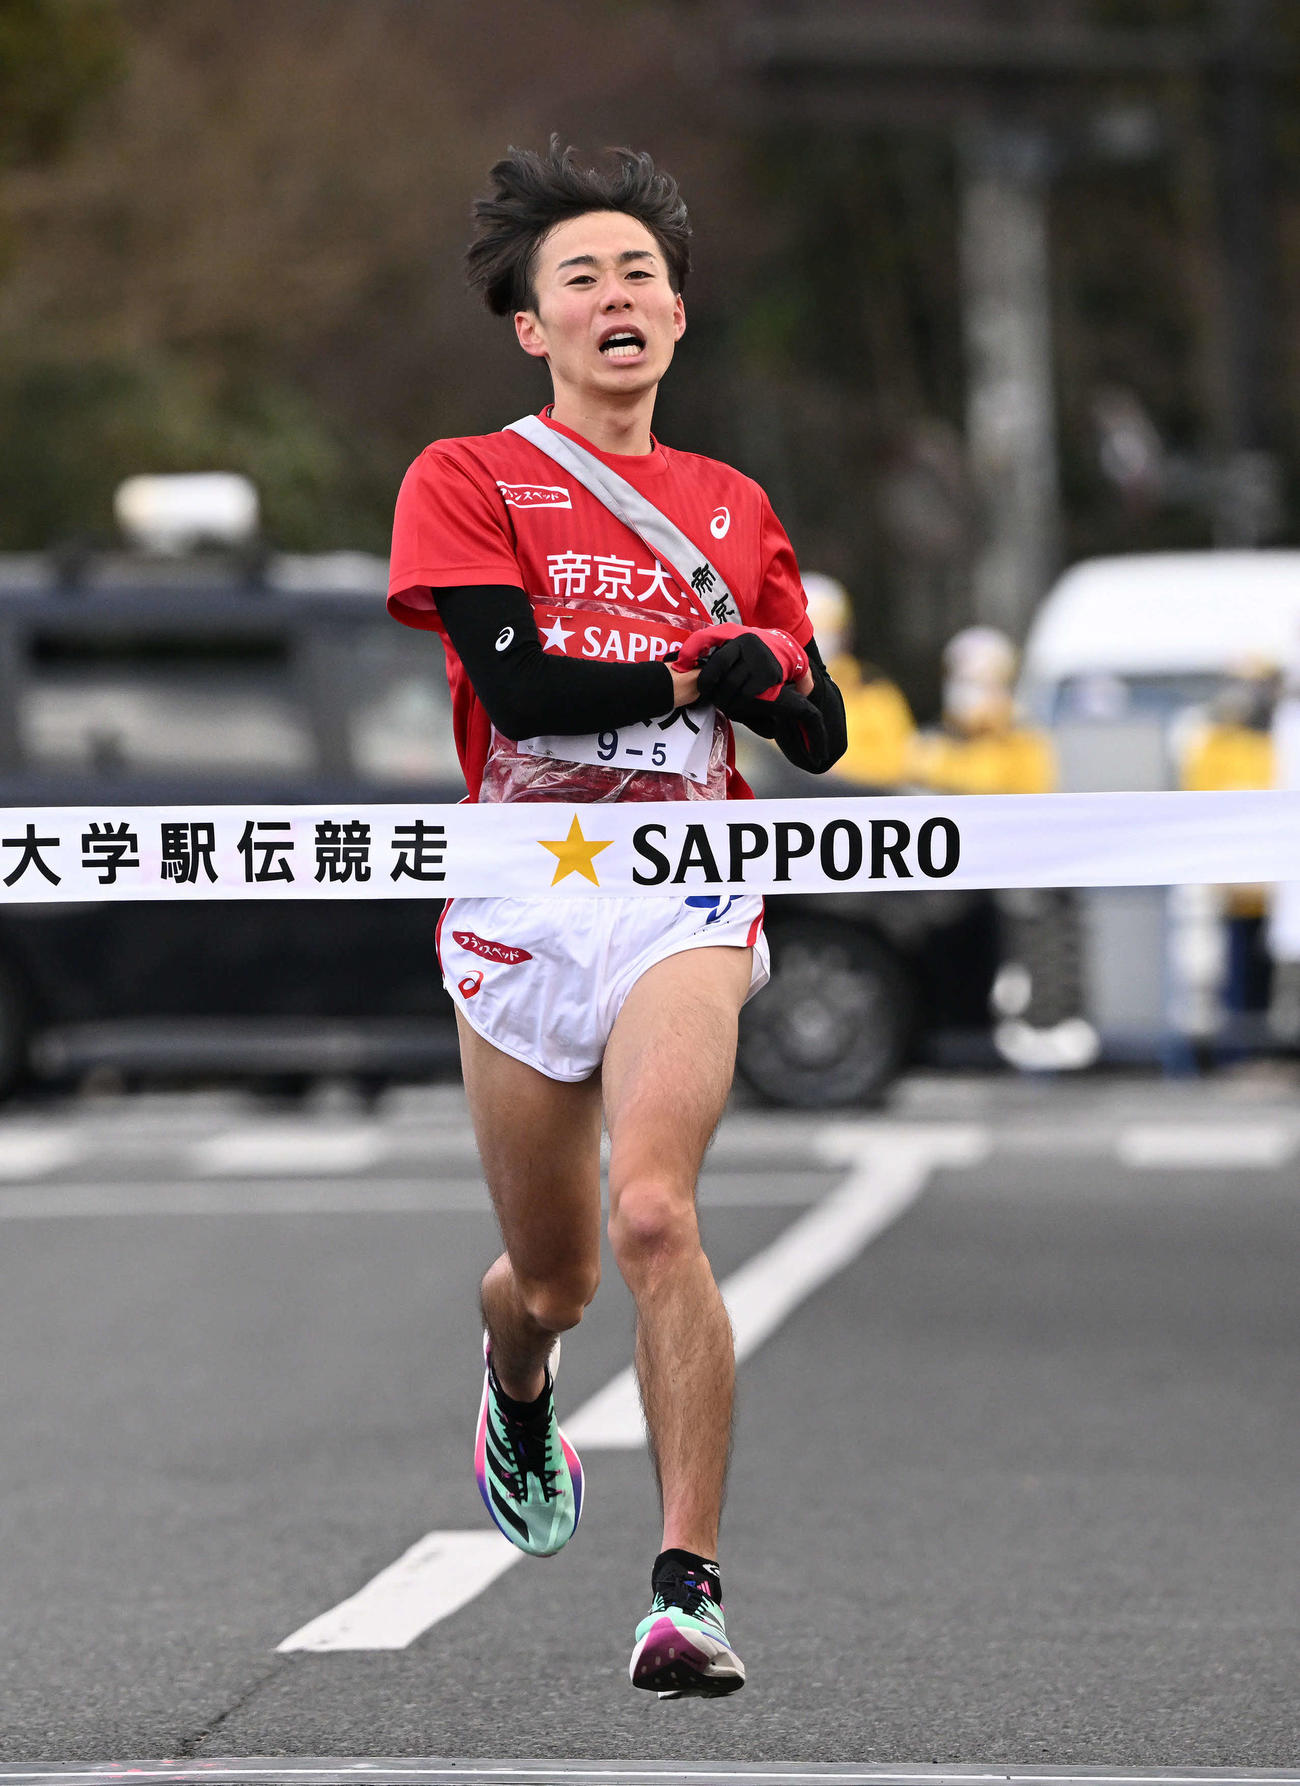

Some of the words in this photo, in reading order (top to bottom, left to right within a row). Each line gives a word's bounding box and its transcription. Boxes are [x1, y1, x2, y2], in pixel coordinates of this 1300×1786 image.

[547, 550, 700, 616] 帝京大
[3, 819, 449, 886] 大学駅伝競走
[631, 816, 963, 886] SAPPORO
